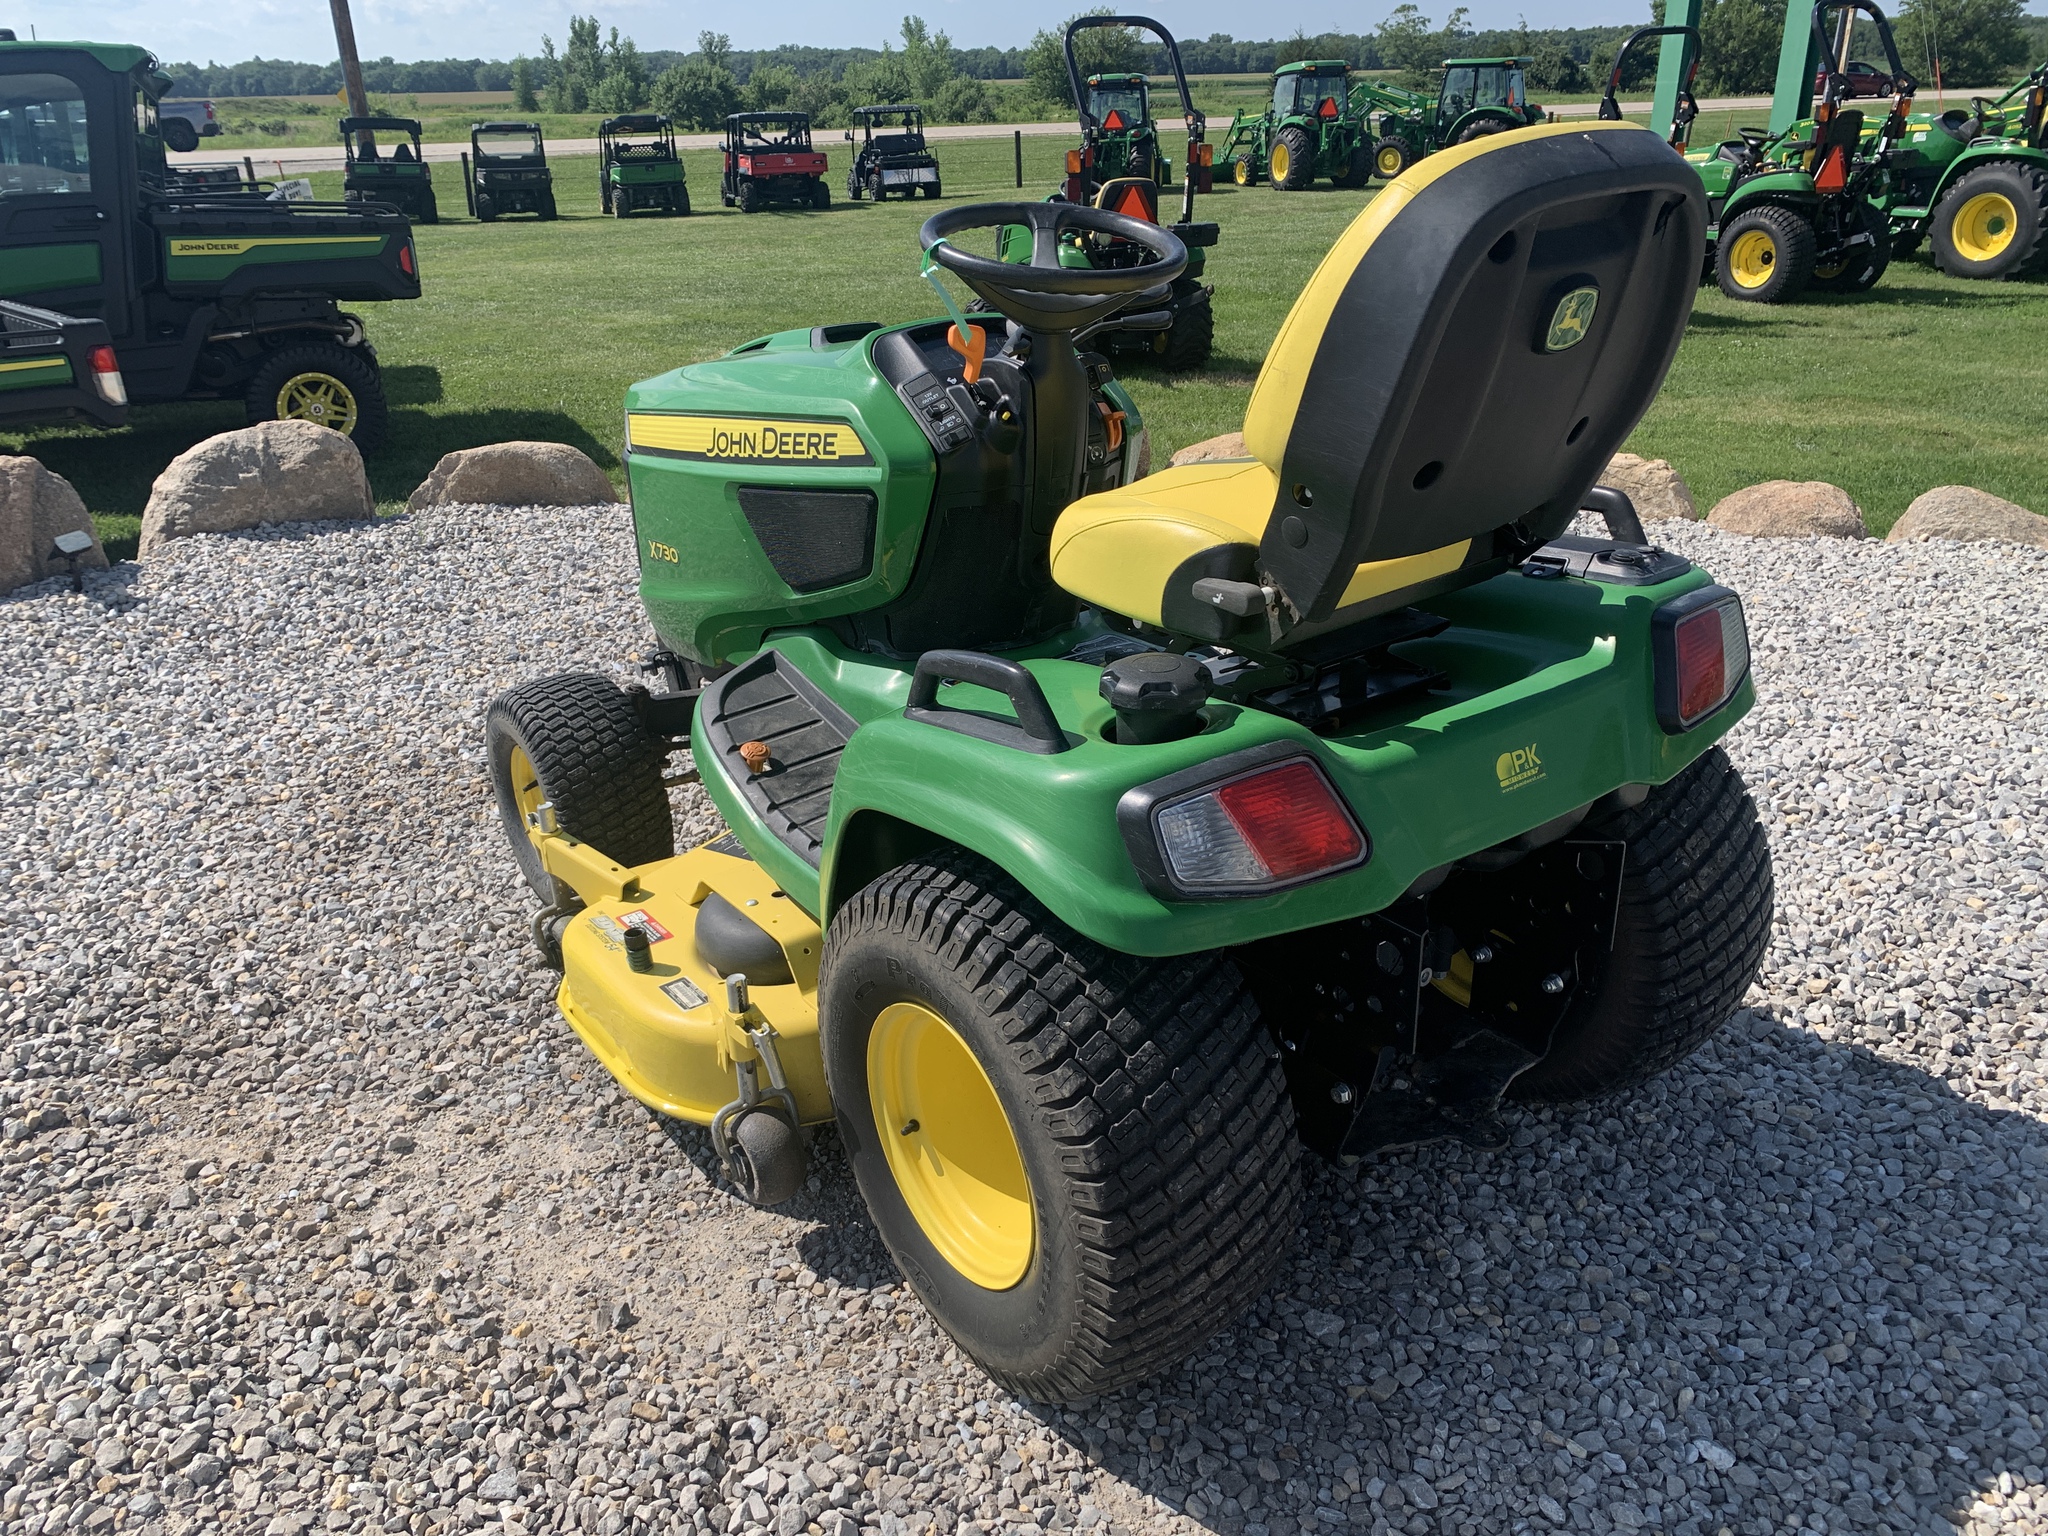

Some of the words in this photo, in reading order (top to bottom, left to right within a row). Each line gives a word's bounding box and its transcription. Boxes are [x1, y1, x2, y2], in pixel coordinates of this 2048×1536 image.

[922, 393, 939, 404] OUTLET
[939, 415, 955, 425] LIGHTS
[706, 427, 757, 454] JOHN
[762, 427, 838, 455] DEERE
[648, 540, 679, 563] X730
